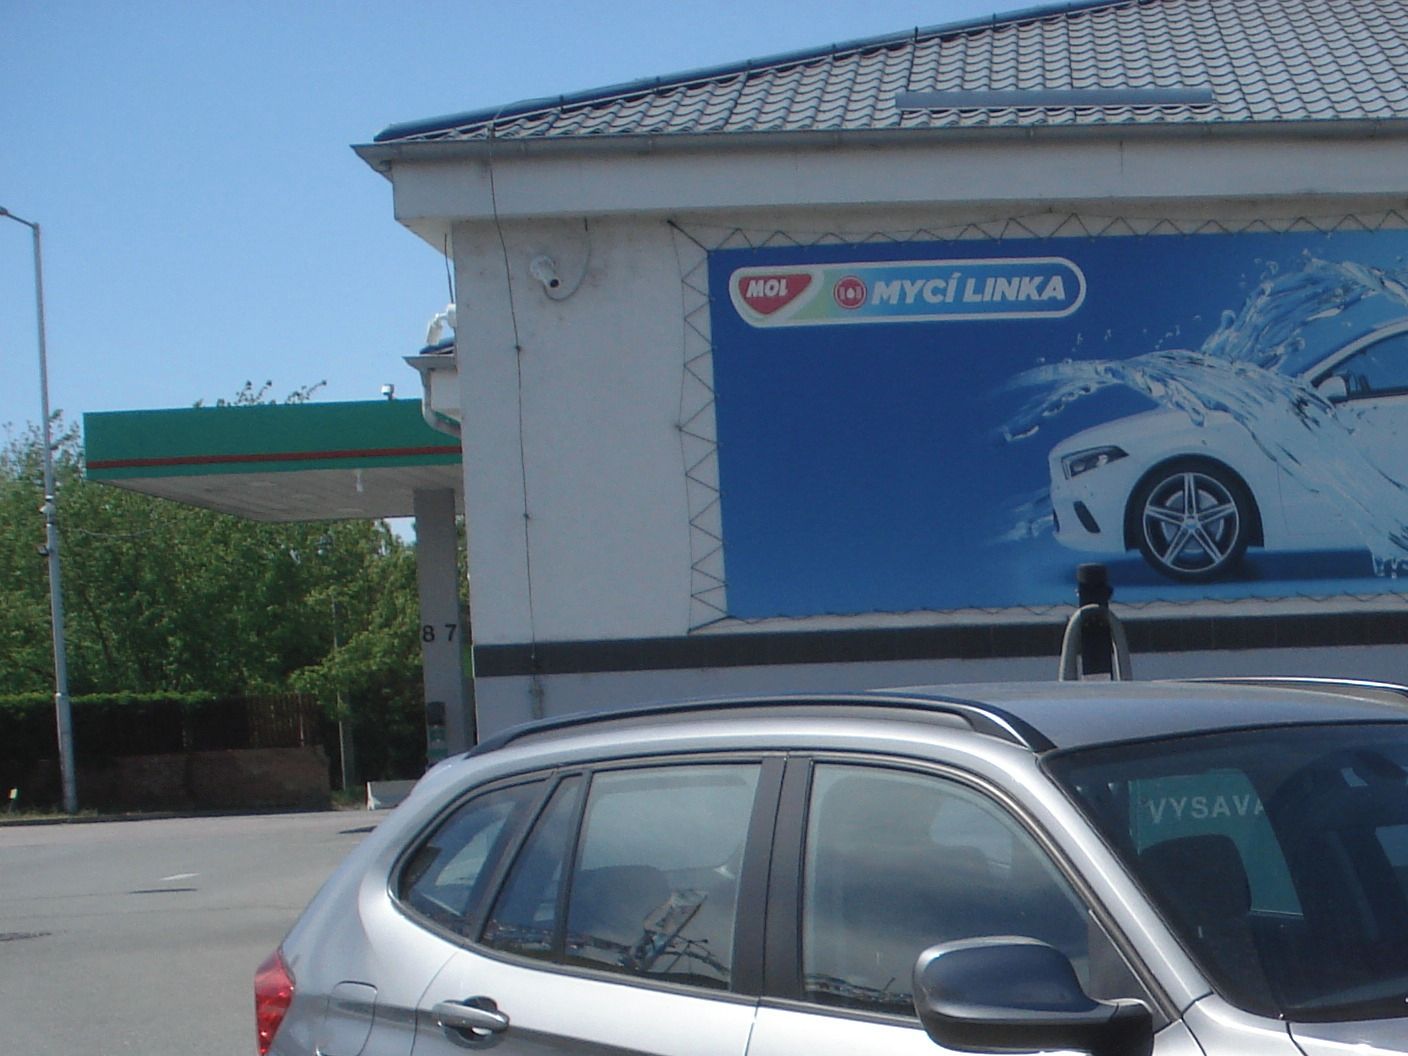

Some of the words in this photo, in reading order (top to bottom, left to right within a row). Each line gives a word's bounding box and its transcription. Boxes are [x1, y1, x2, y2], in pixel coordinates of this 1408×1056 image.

[746, 278, 788, 297] MOL
[872, 272, 961, 305] MYCÍ
[963, 275, 1066, 303] LINKA
